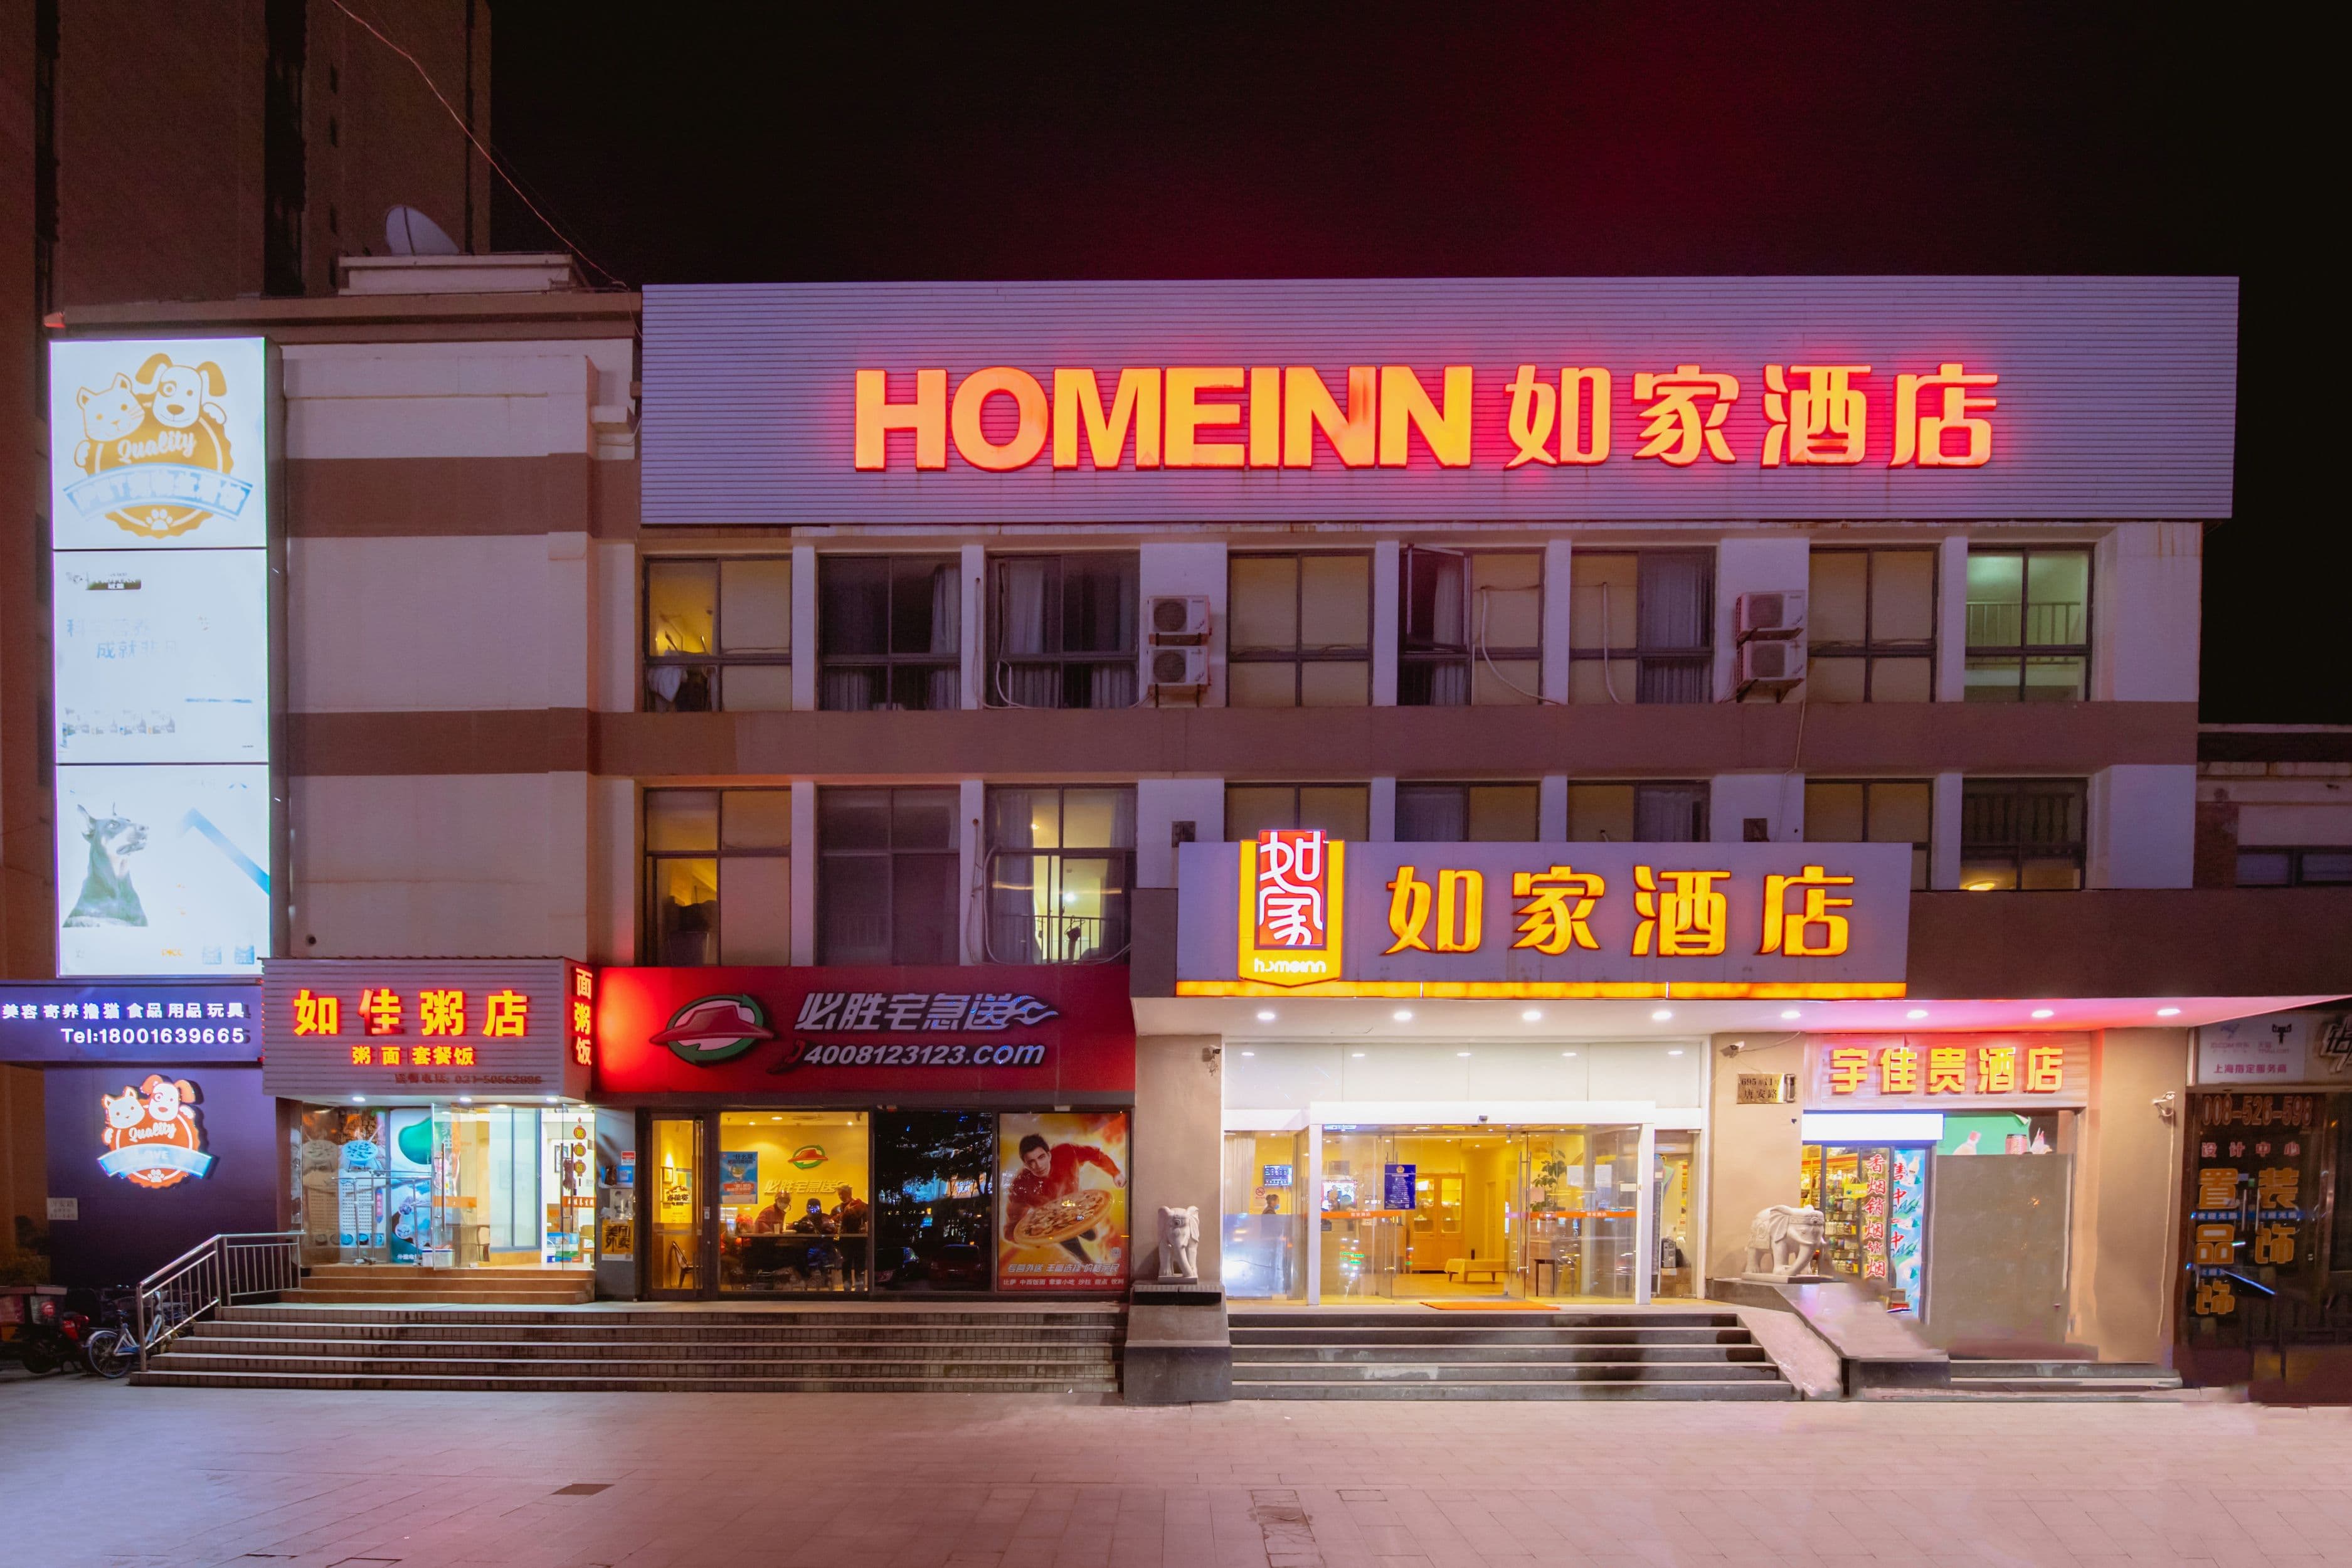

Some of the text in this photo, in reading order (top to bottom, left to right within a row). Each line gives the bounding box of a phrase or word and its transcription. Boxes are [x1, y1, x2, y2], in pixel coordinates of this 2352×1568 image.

[854, 366, 1474, 471] HOMEINN
[1505, 363, 2000, 469] 如家酒店
[117, 430, 197, 464] Quality
[1385, 865, 1855, 956] 如家酒店
[2, 1004, 38, 1019] 美容
[43, 1004, 79, 1019] 寄养
[127, 1004, 163, 1019] 食品
[167, 1004, 202, 1019] 用品
[207, 1004, 245, 1019] 玩具
[293, 988, 529, 1037] 如佳粥店
[574, 967, 592, 1066] 面粥饭
[794, 992, 1029, 1031] 必胜宅急送
[61, 1027, 245, 1044] Tel:18001639665
[352, 1045, 475, 1066] 粥 面 套餐饭
[803, 1044, 1046, 1065] 4008123123.com
[1830, 1047, 2064, 1093] 宇佳贵酒店
[2213, 1064, 2287, 1074] 上海指定服务商
[1744, 1089, 1777, 1099] 唐安路
[2201, 1141, 2301, 1158] 设计中心
[605, 1225, 631, 1237] 美团
